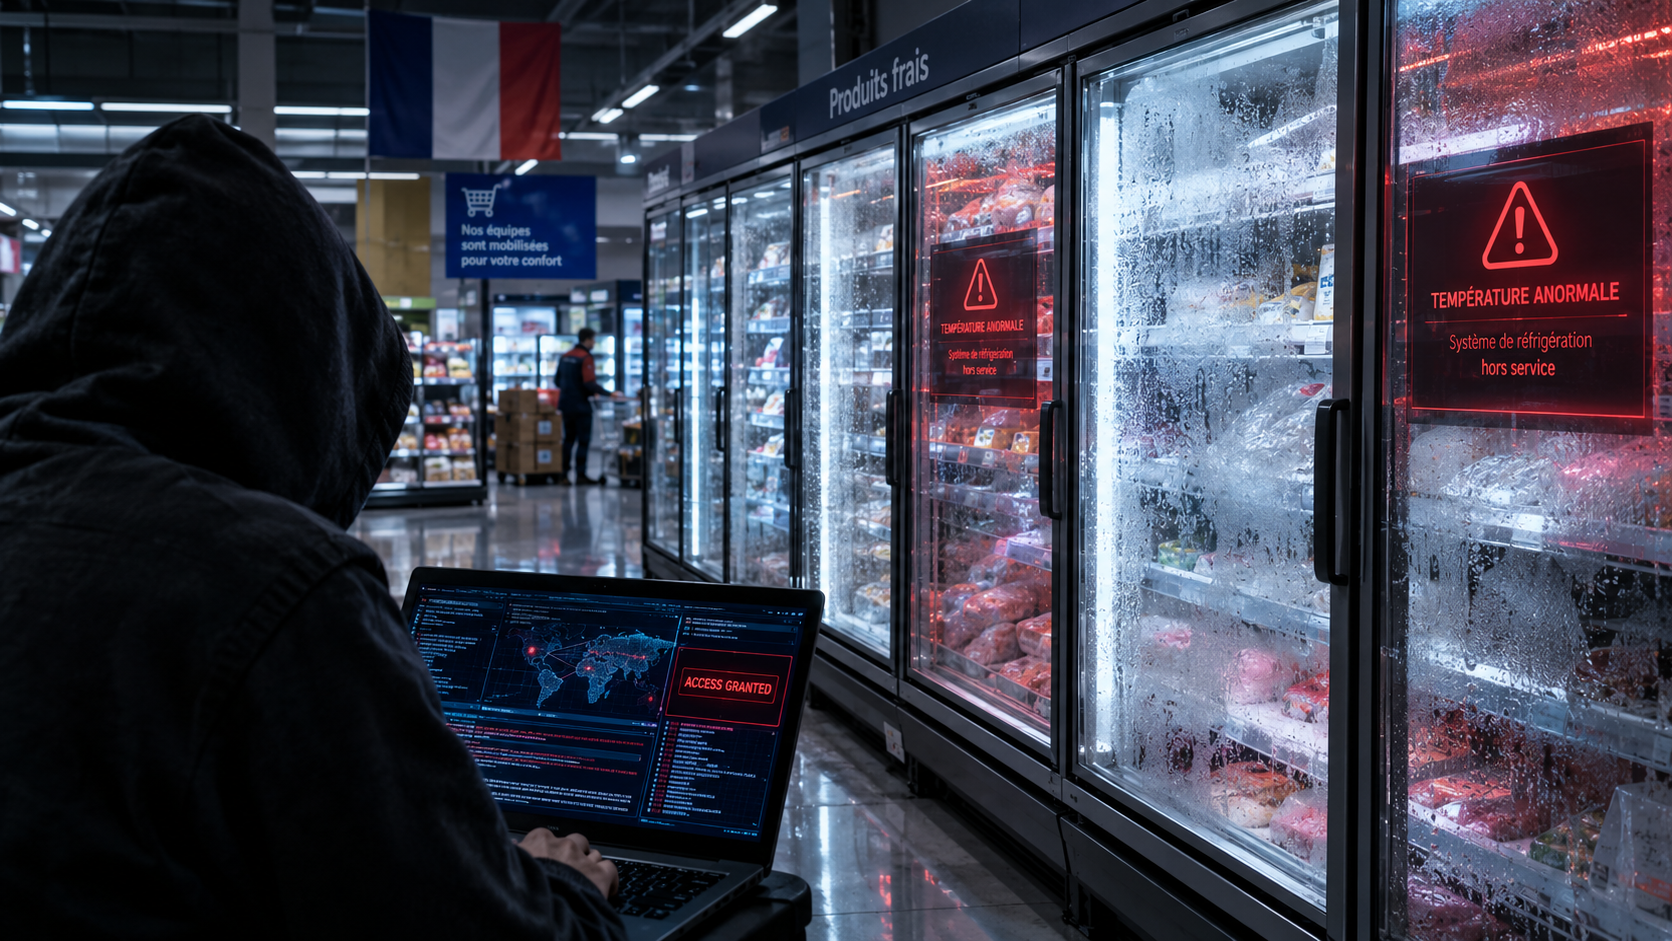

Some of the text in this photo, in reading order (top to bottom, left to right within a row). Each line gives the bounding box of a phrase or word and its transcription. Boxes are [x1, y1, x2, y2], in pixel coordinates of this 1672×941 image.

[829, 47, 930, 119] Produits frais
[461, 224, 531, 238] Nos équipes
[461, 239, 549, 251] sont mobilisées
[461, 254, 563, 268] pour votre confort
[1431, 281, 1620, 309] TEMPÉRATURE ANORMALE
[941, 319, 1024, 334] TEMPÉRATURE ANORMALE
[1450, 331, 1593, 353] Système de réfrigération
[971, 349, 978, 359] de
[963, 363, 997, 375] hors service
[1481, 358, 1556, 376] hors service
[684, 676, 772, 695] ACCESS GRANTED
